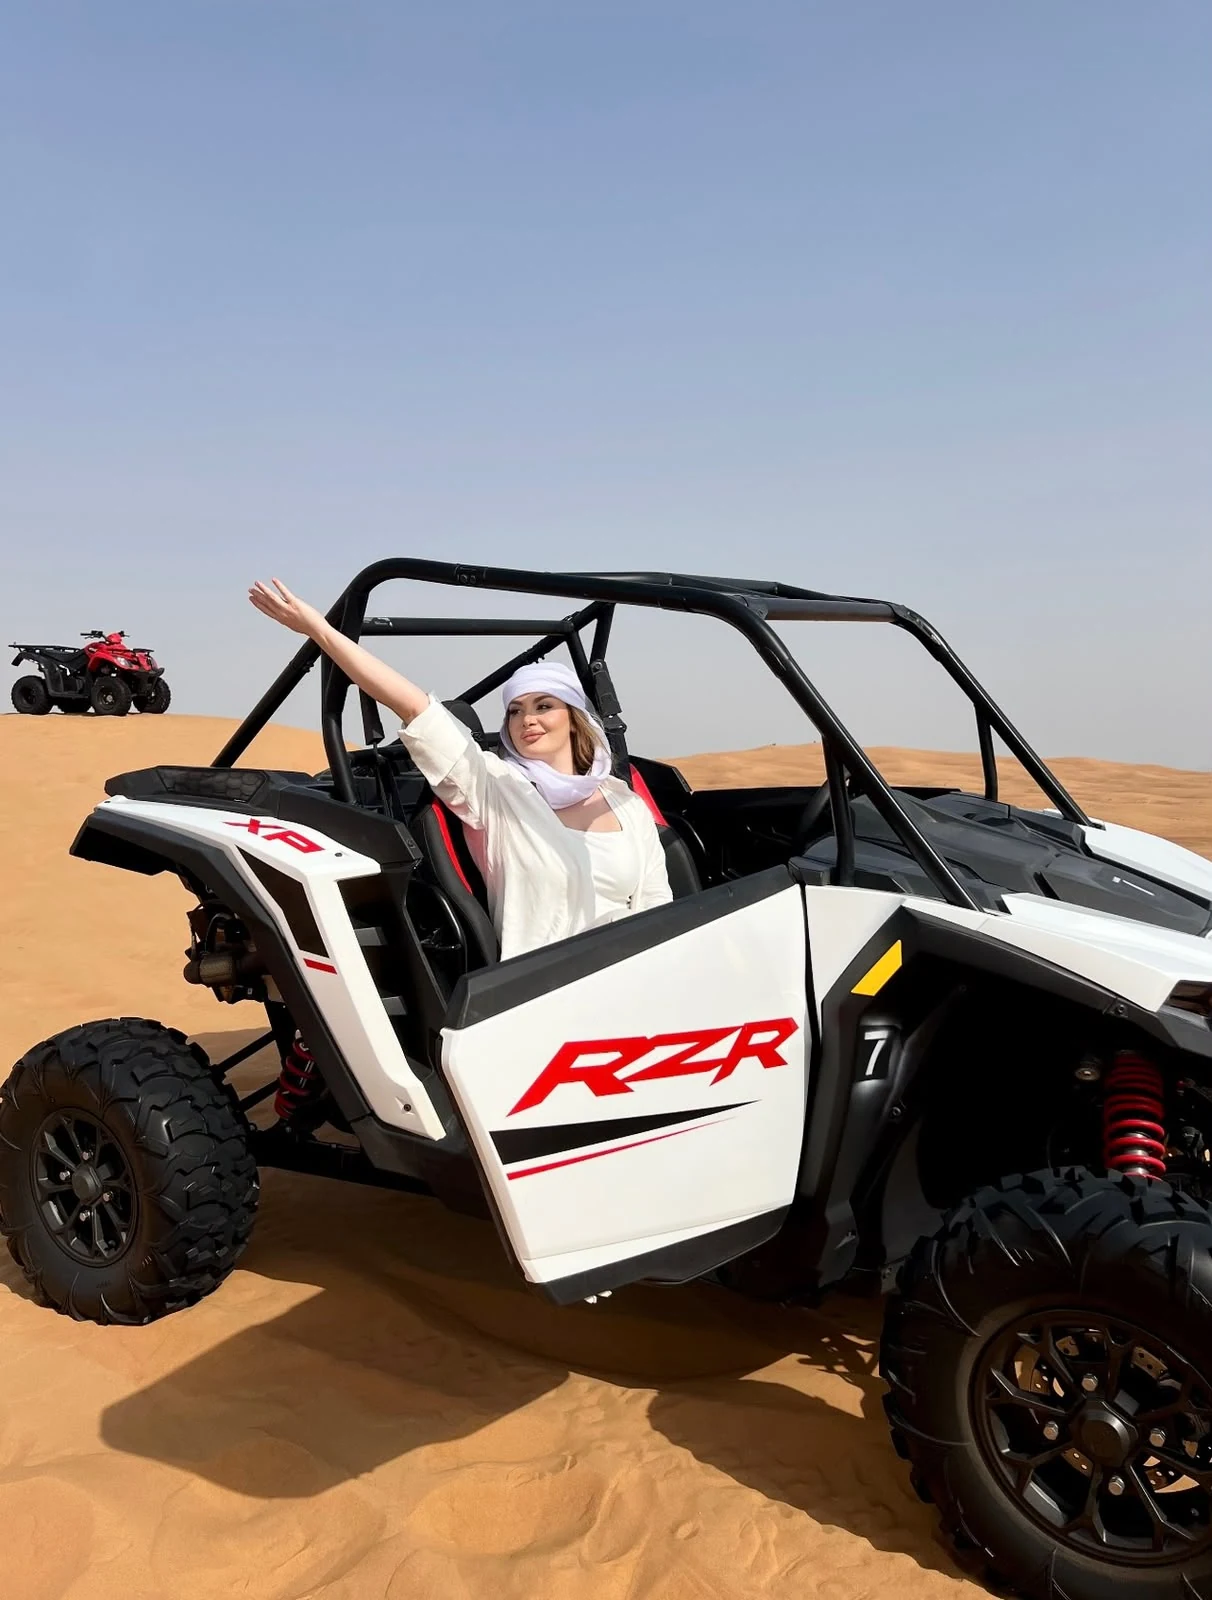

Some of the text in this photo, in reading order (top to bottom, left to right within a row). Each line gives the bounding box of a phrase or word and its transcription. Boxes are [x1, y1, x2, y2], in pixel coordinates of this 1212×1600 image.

[222, 818, 325, 854] XP
[506, 1017, 799, 1117] RZR
[864, 1030, 889, 1076] 7
